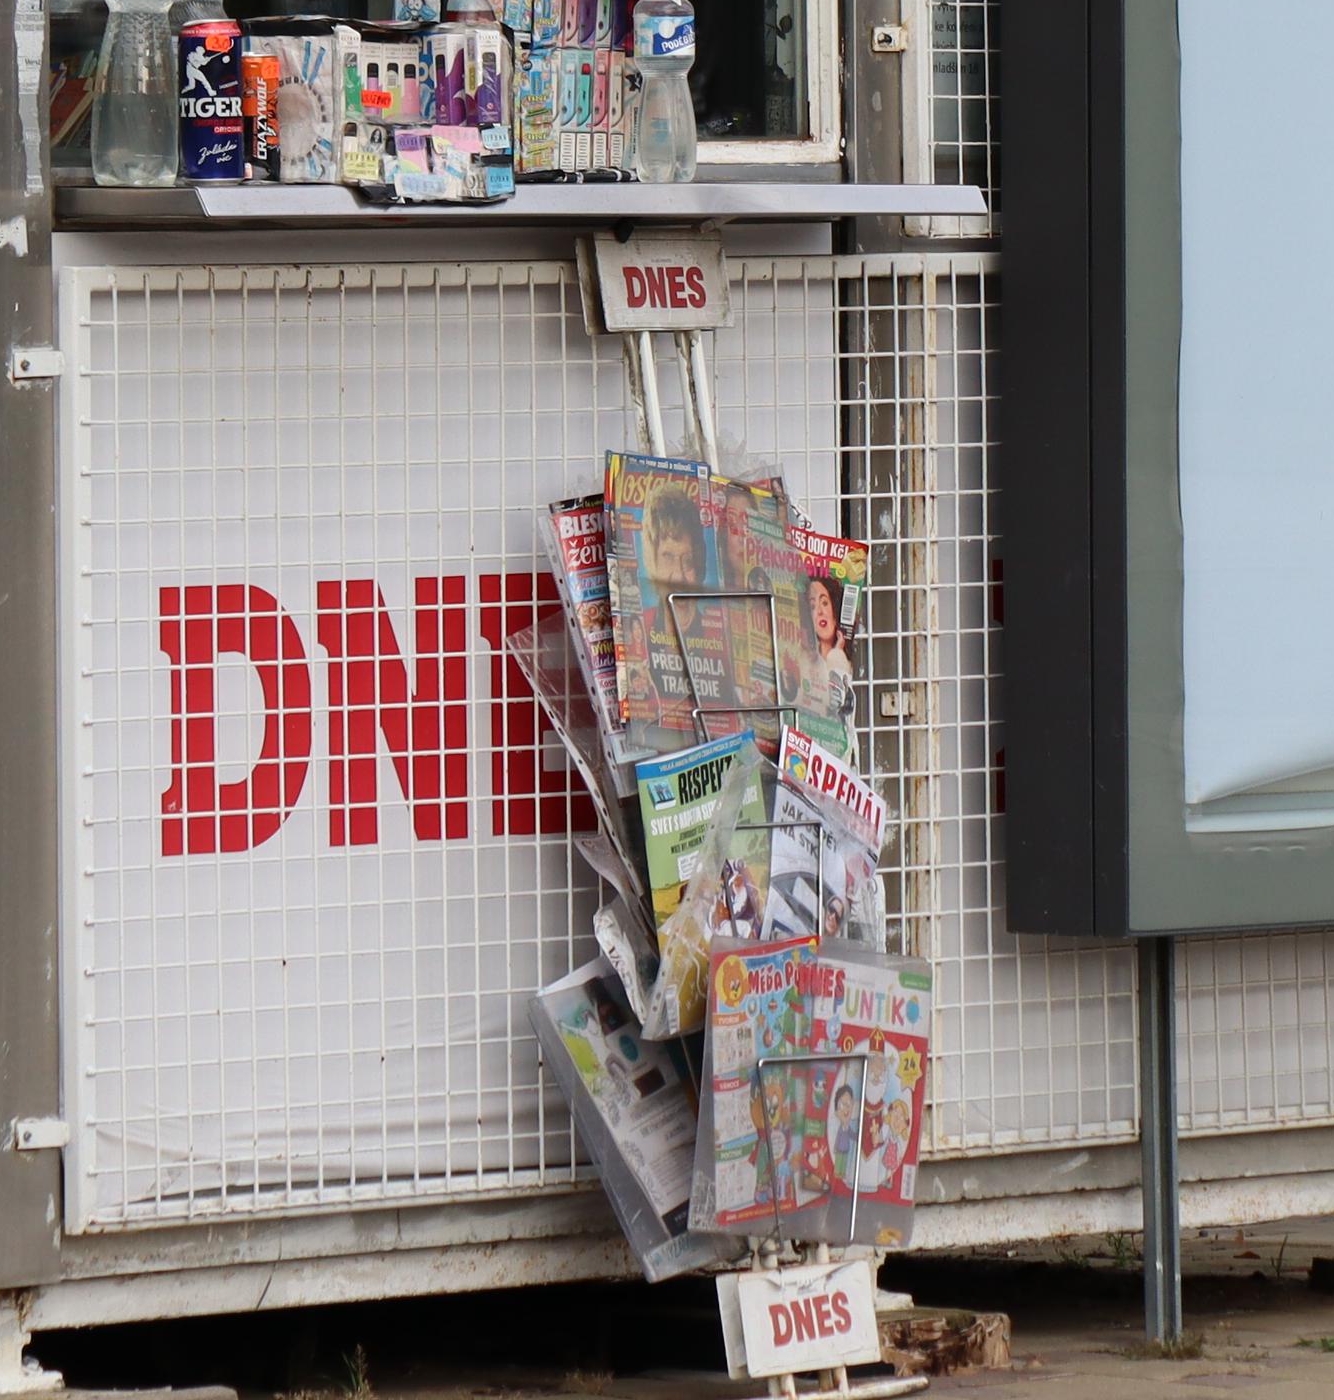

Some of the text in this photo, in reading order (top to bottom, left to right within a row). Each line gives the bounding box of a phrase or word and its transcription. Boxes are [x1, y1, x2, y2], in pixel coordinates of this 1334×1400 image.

[179, 96, 243, 118] TIGER
[256, 76, 268, 160] CRAZYWOLF
[624, 266, 707, 309] DNES
[583, 536, 597, 546] pro
[791, 530, 806, 550] 155
[807, 535, 828, 556] 000
[789, 731, 810, 751] SVĚT
[782, 800, 803, 822] JAK
[903, 1058, 917, 1071] 24
[769, 1292, 852, 1347] DNES
